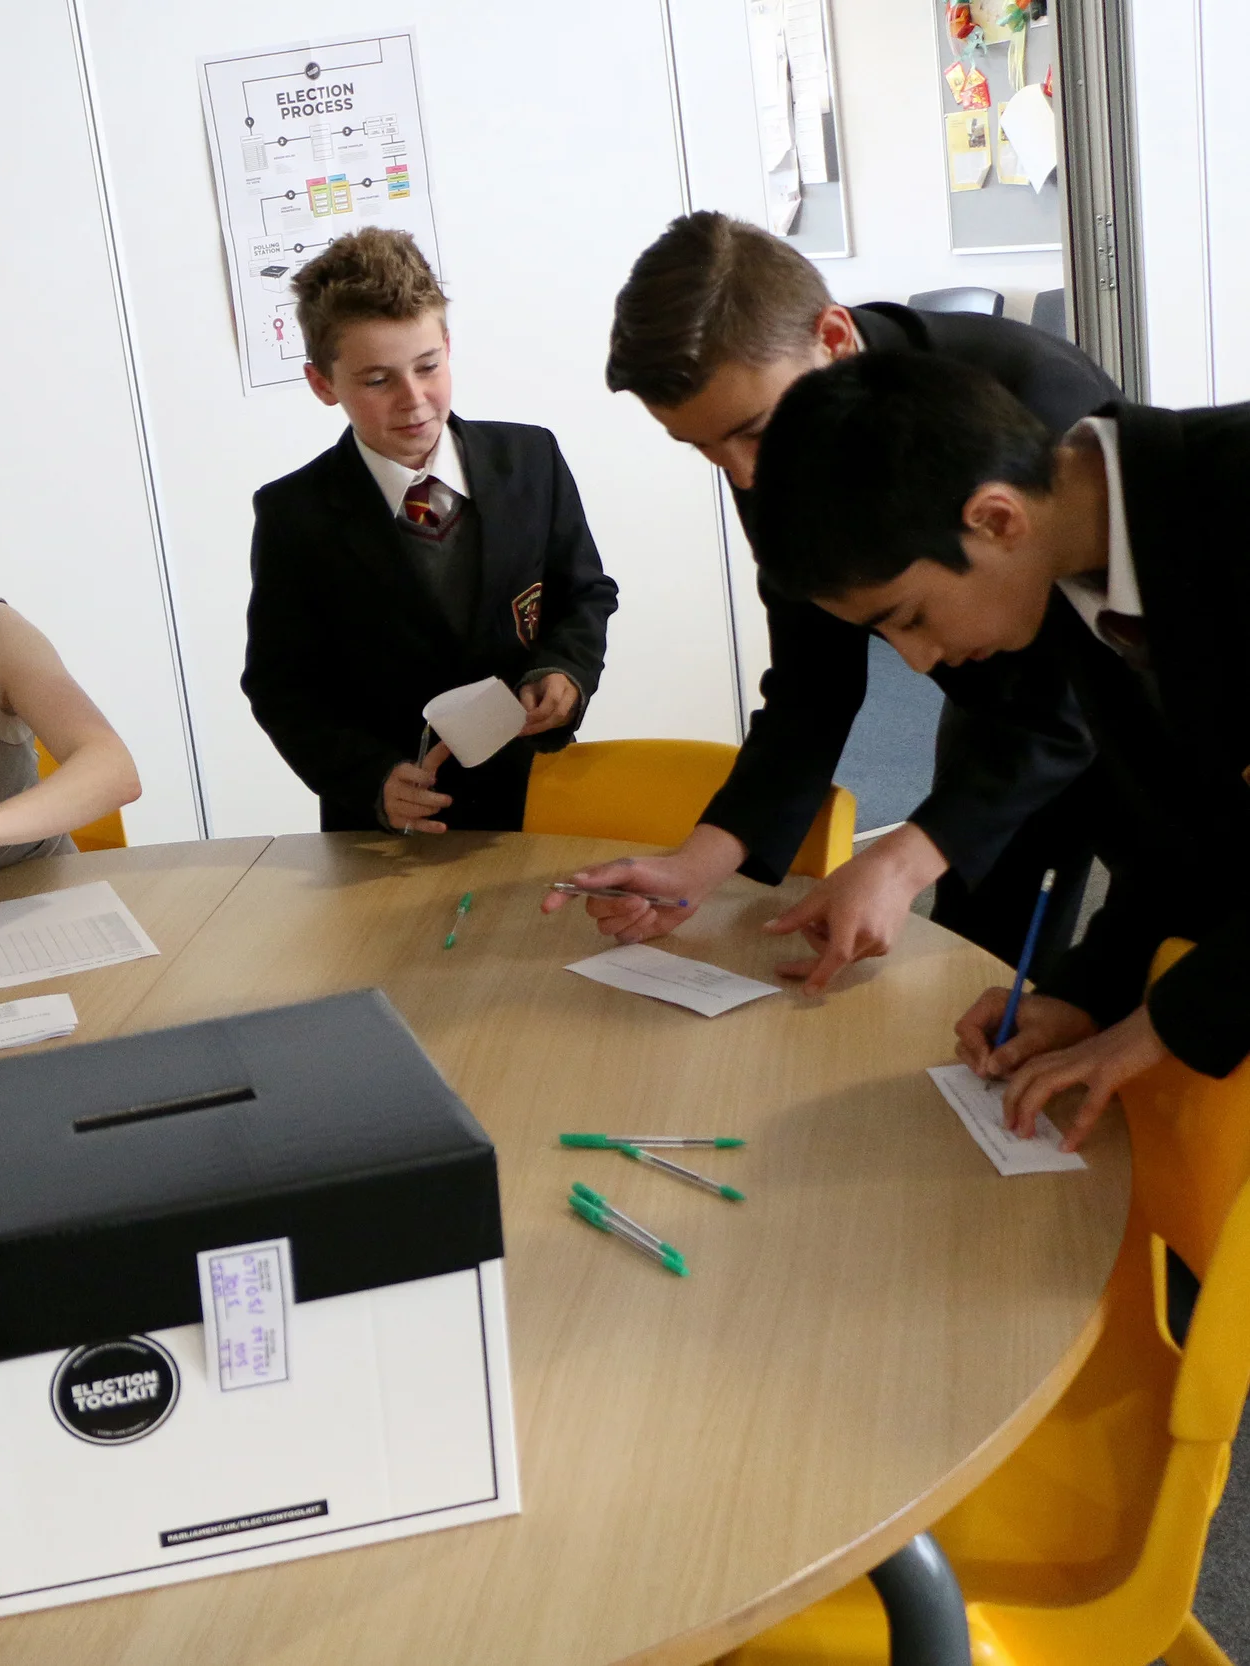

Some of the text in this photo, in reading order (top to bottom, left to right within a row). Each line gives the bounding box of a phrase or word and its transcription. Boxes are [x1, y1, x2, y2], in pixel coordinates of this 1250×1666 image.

[276, 83, 354, 105] ELECTION
[281, 98, 353, 120] PROCESS
[253, 242, 280, 251] POLLING
[254, 248, 281, 256] STATION
[71, 1370, 159, 1398] ELECTION
[73, 1382, 159, 1412] TOOLKIT
